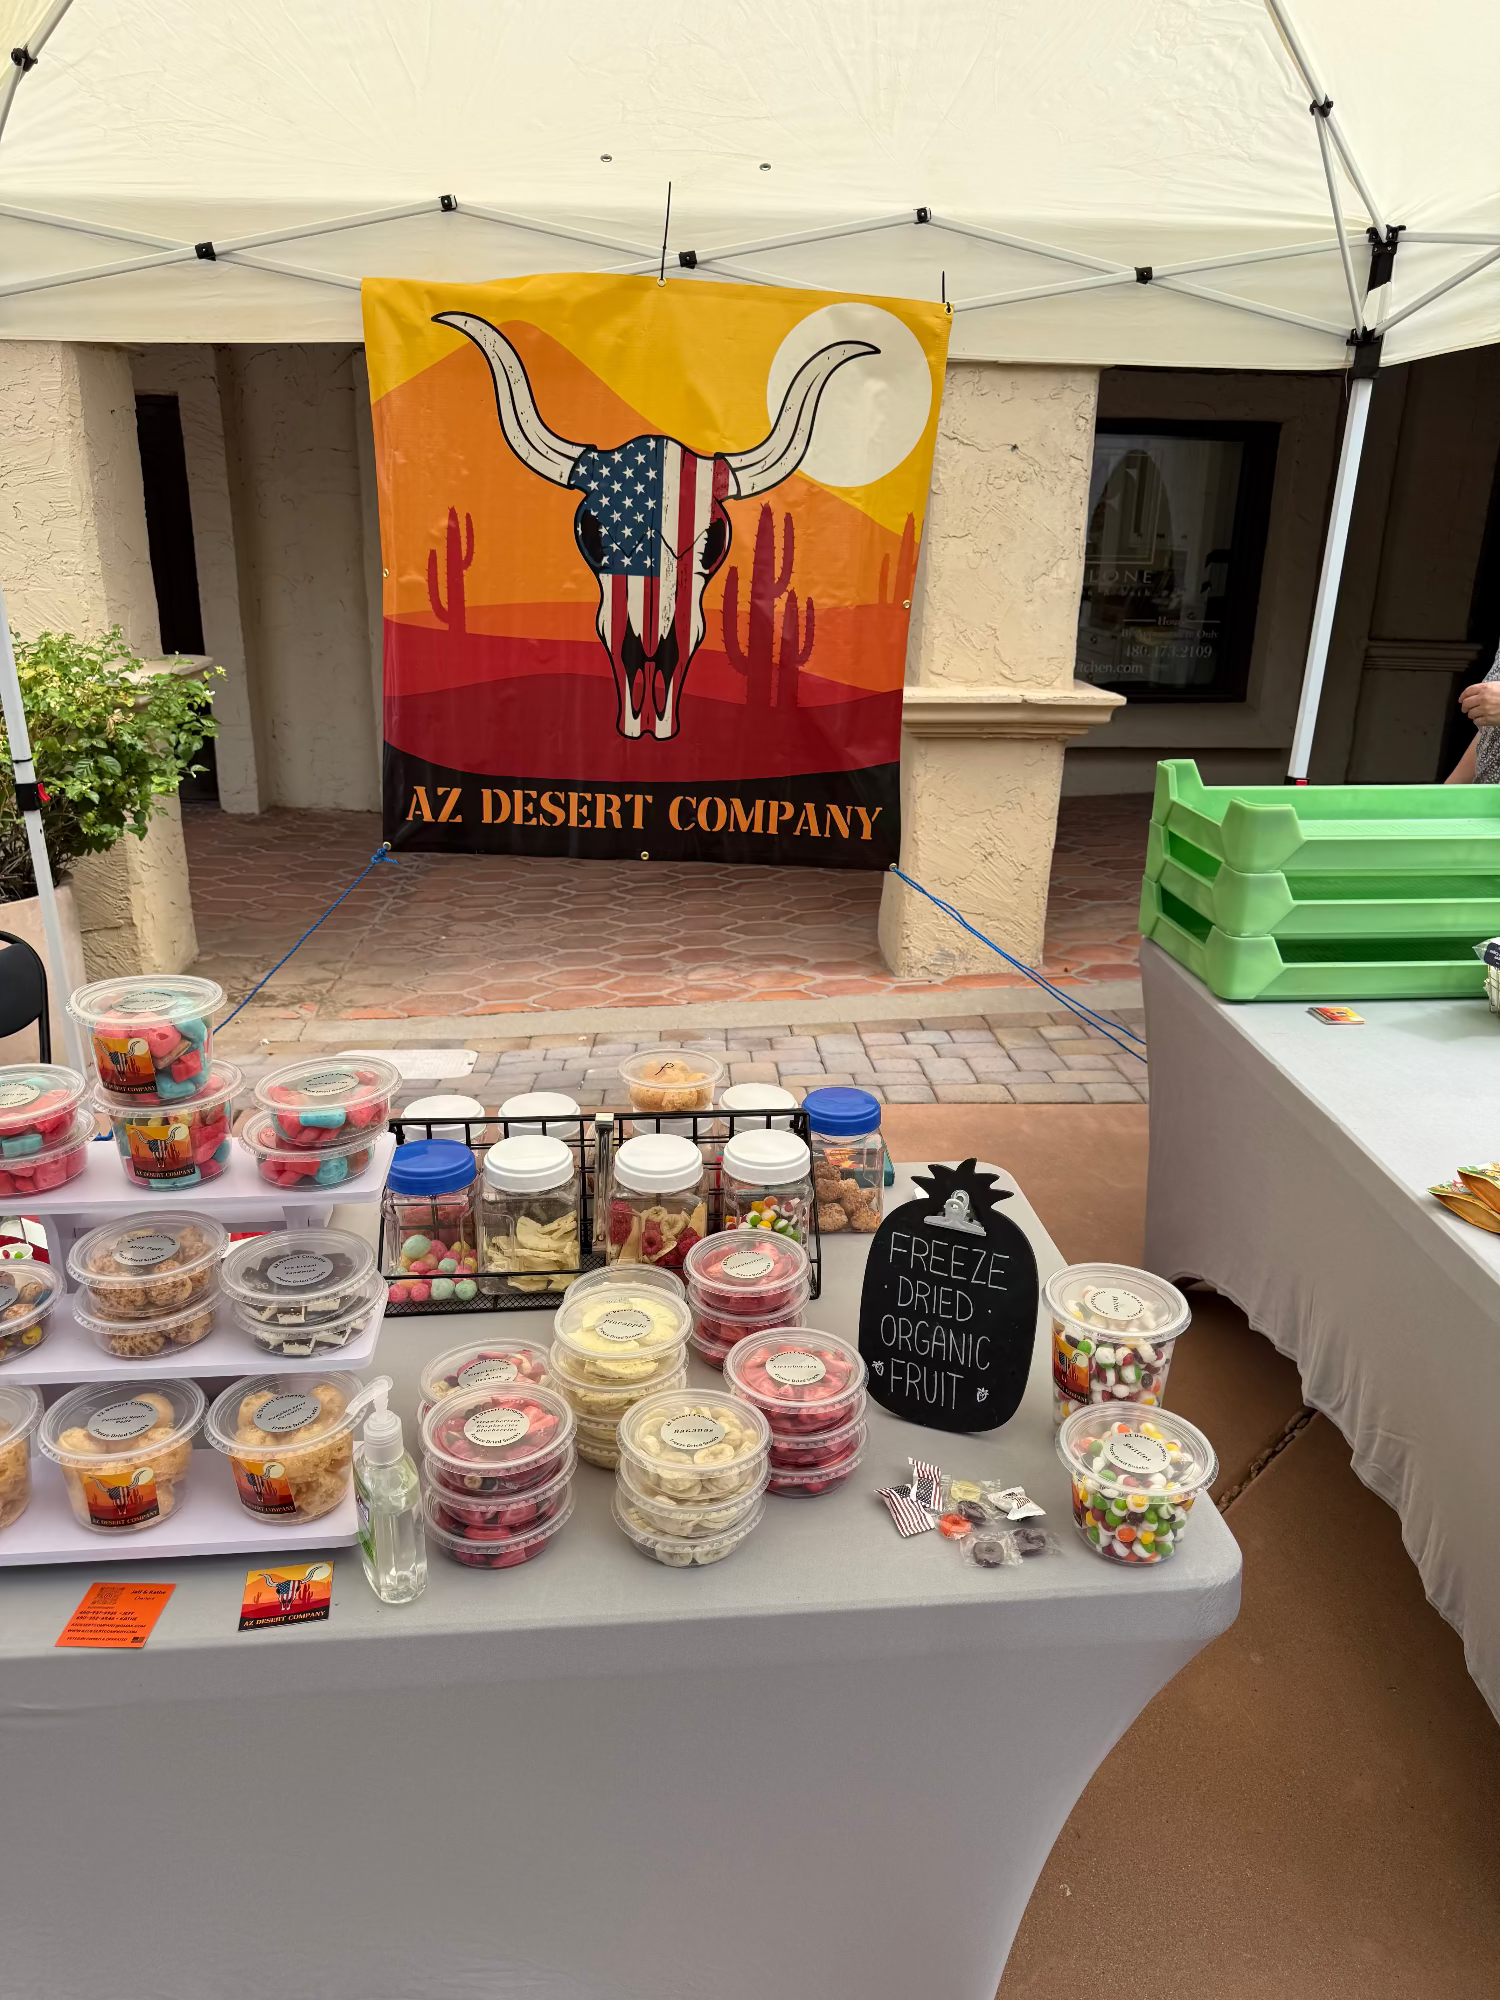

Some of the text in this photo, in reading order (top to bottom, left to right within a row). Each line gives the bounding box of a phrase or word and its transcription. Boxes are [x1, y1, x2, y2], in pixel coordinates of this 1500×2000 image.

[1196, 629, 1219, 640] Only
[405, 785, 883, 841] AZ DESERT COMPANY
[166, 1167, 194, 1177] COMPANY
[889, 1231, 1010, 1291] FREEZE
[897, 1275, 974, 1321] DRIED
[880, 1314, 991, 1371] ORGANIC
[890, 1357, 965, 1410] FRUIT
[127, 1510, 158, 1523] COMPANY
[243, 1610, 326, 1627] AZ DESERT COMPANY
